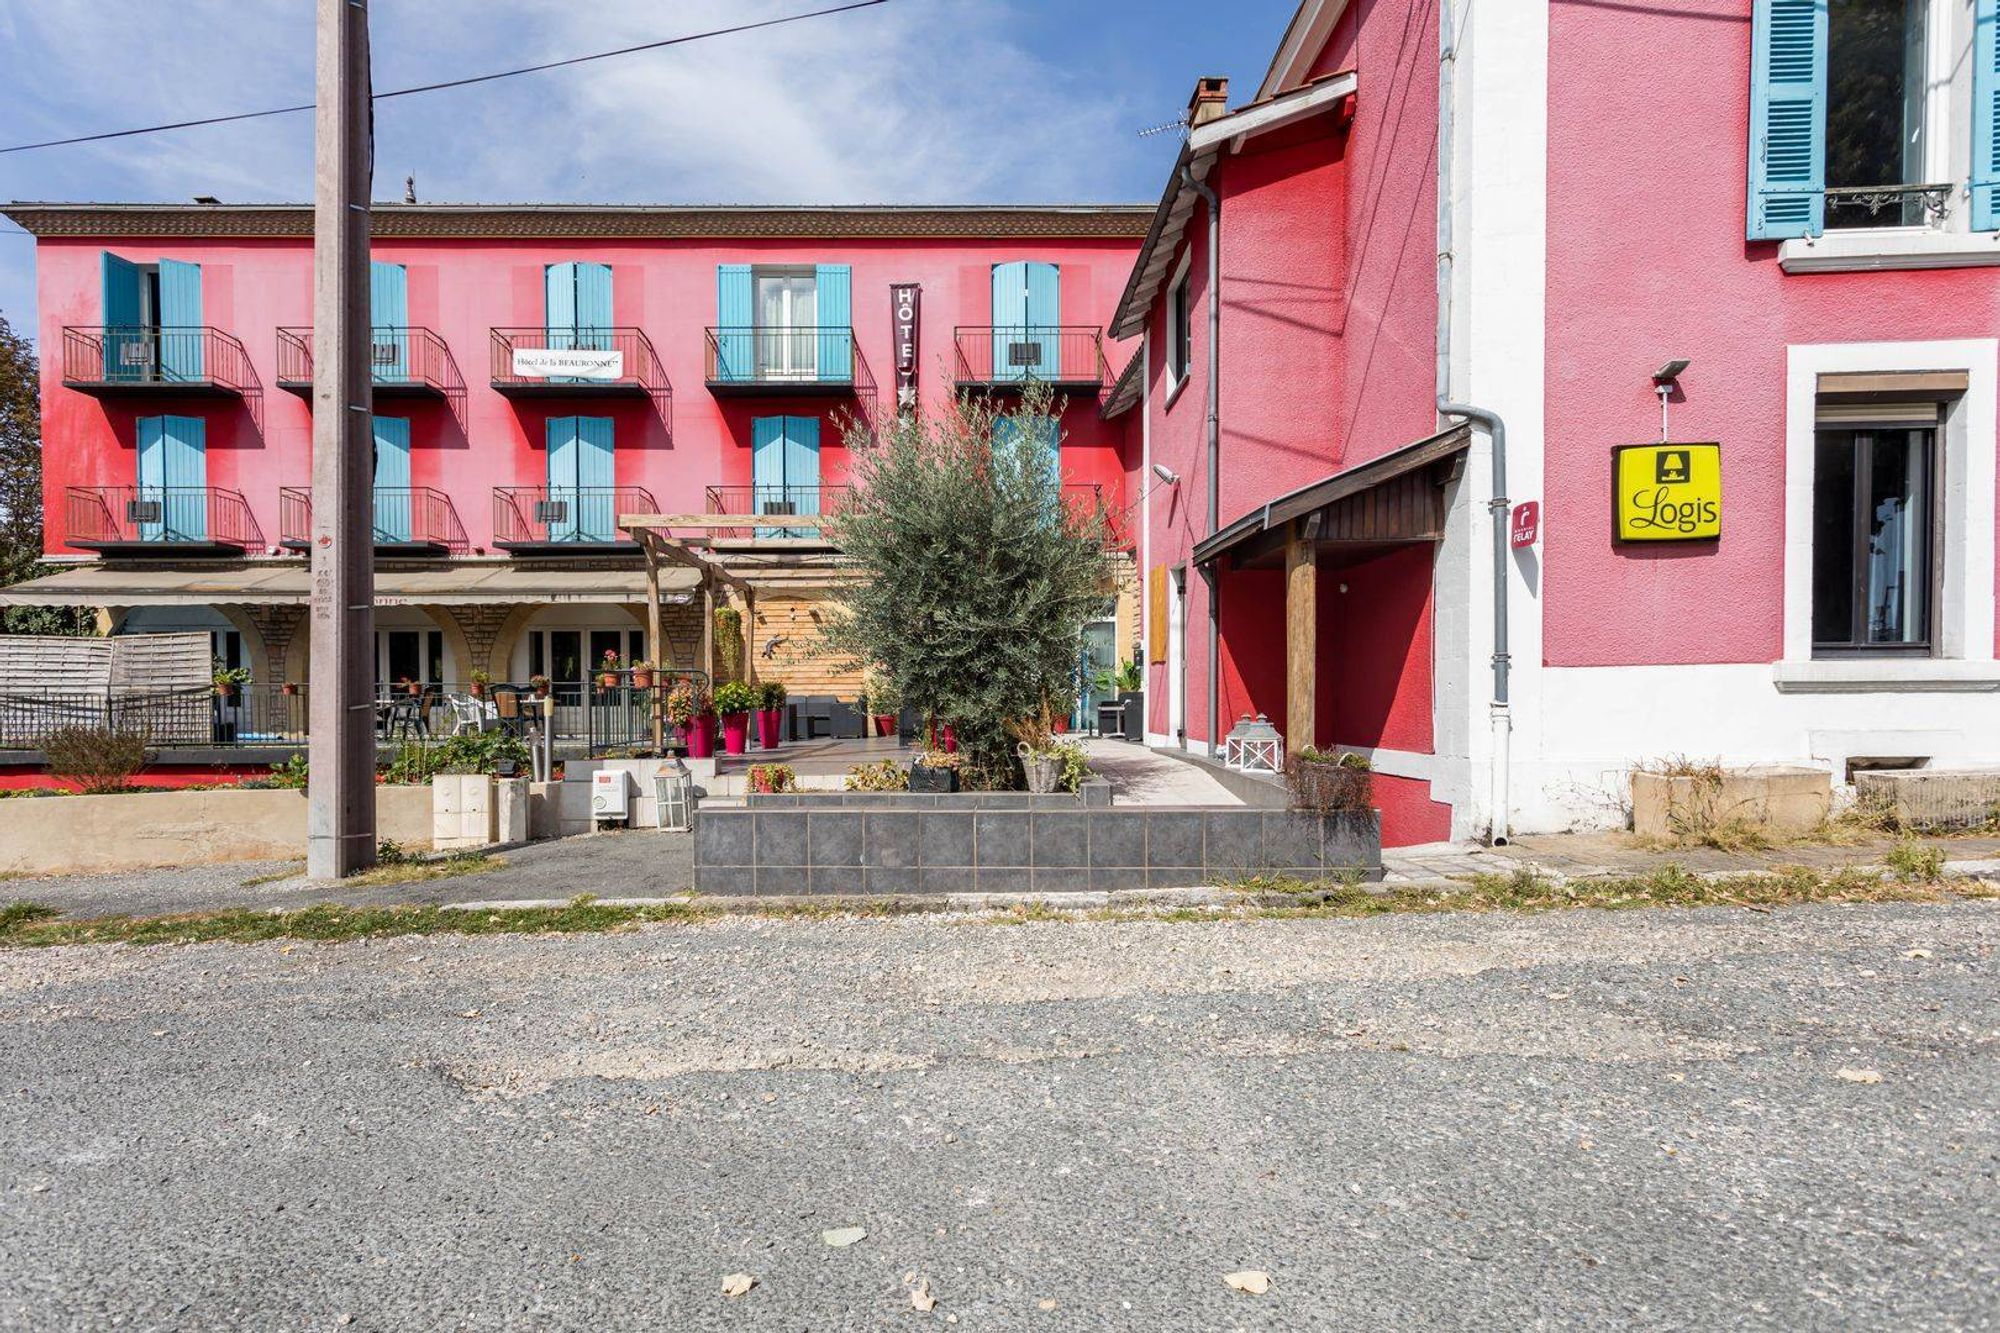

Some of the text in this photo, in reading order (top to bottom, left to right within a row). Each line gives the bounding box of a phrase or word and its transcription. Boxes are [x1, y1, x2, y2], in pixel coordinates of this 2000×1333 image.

[517, 357, 538, 366] Hôtel
[539, 358, 549, 366] de
[550, 358, 557, 366] la
[1629, 486, 1717, 533] Logis
[1513, 530, 1534, 543] RELAY
